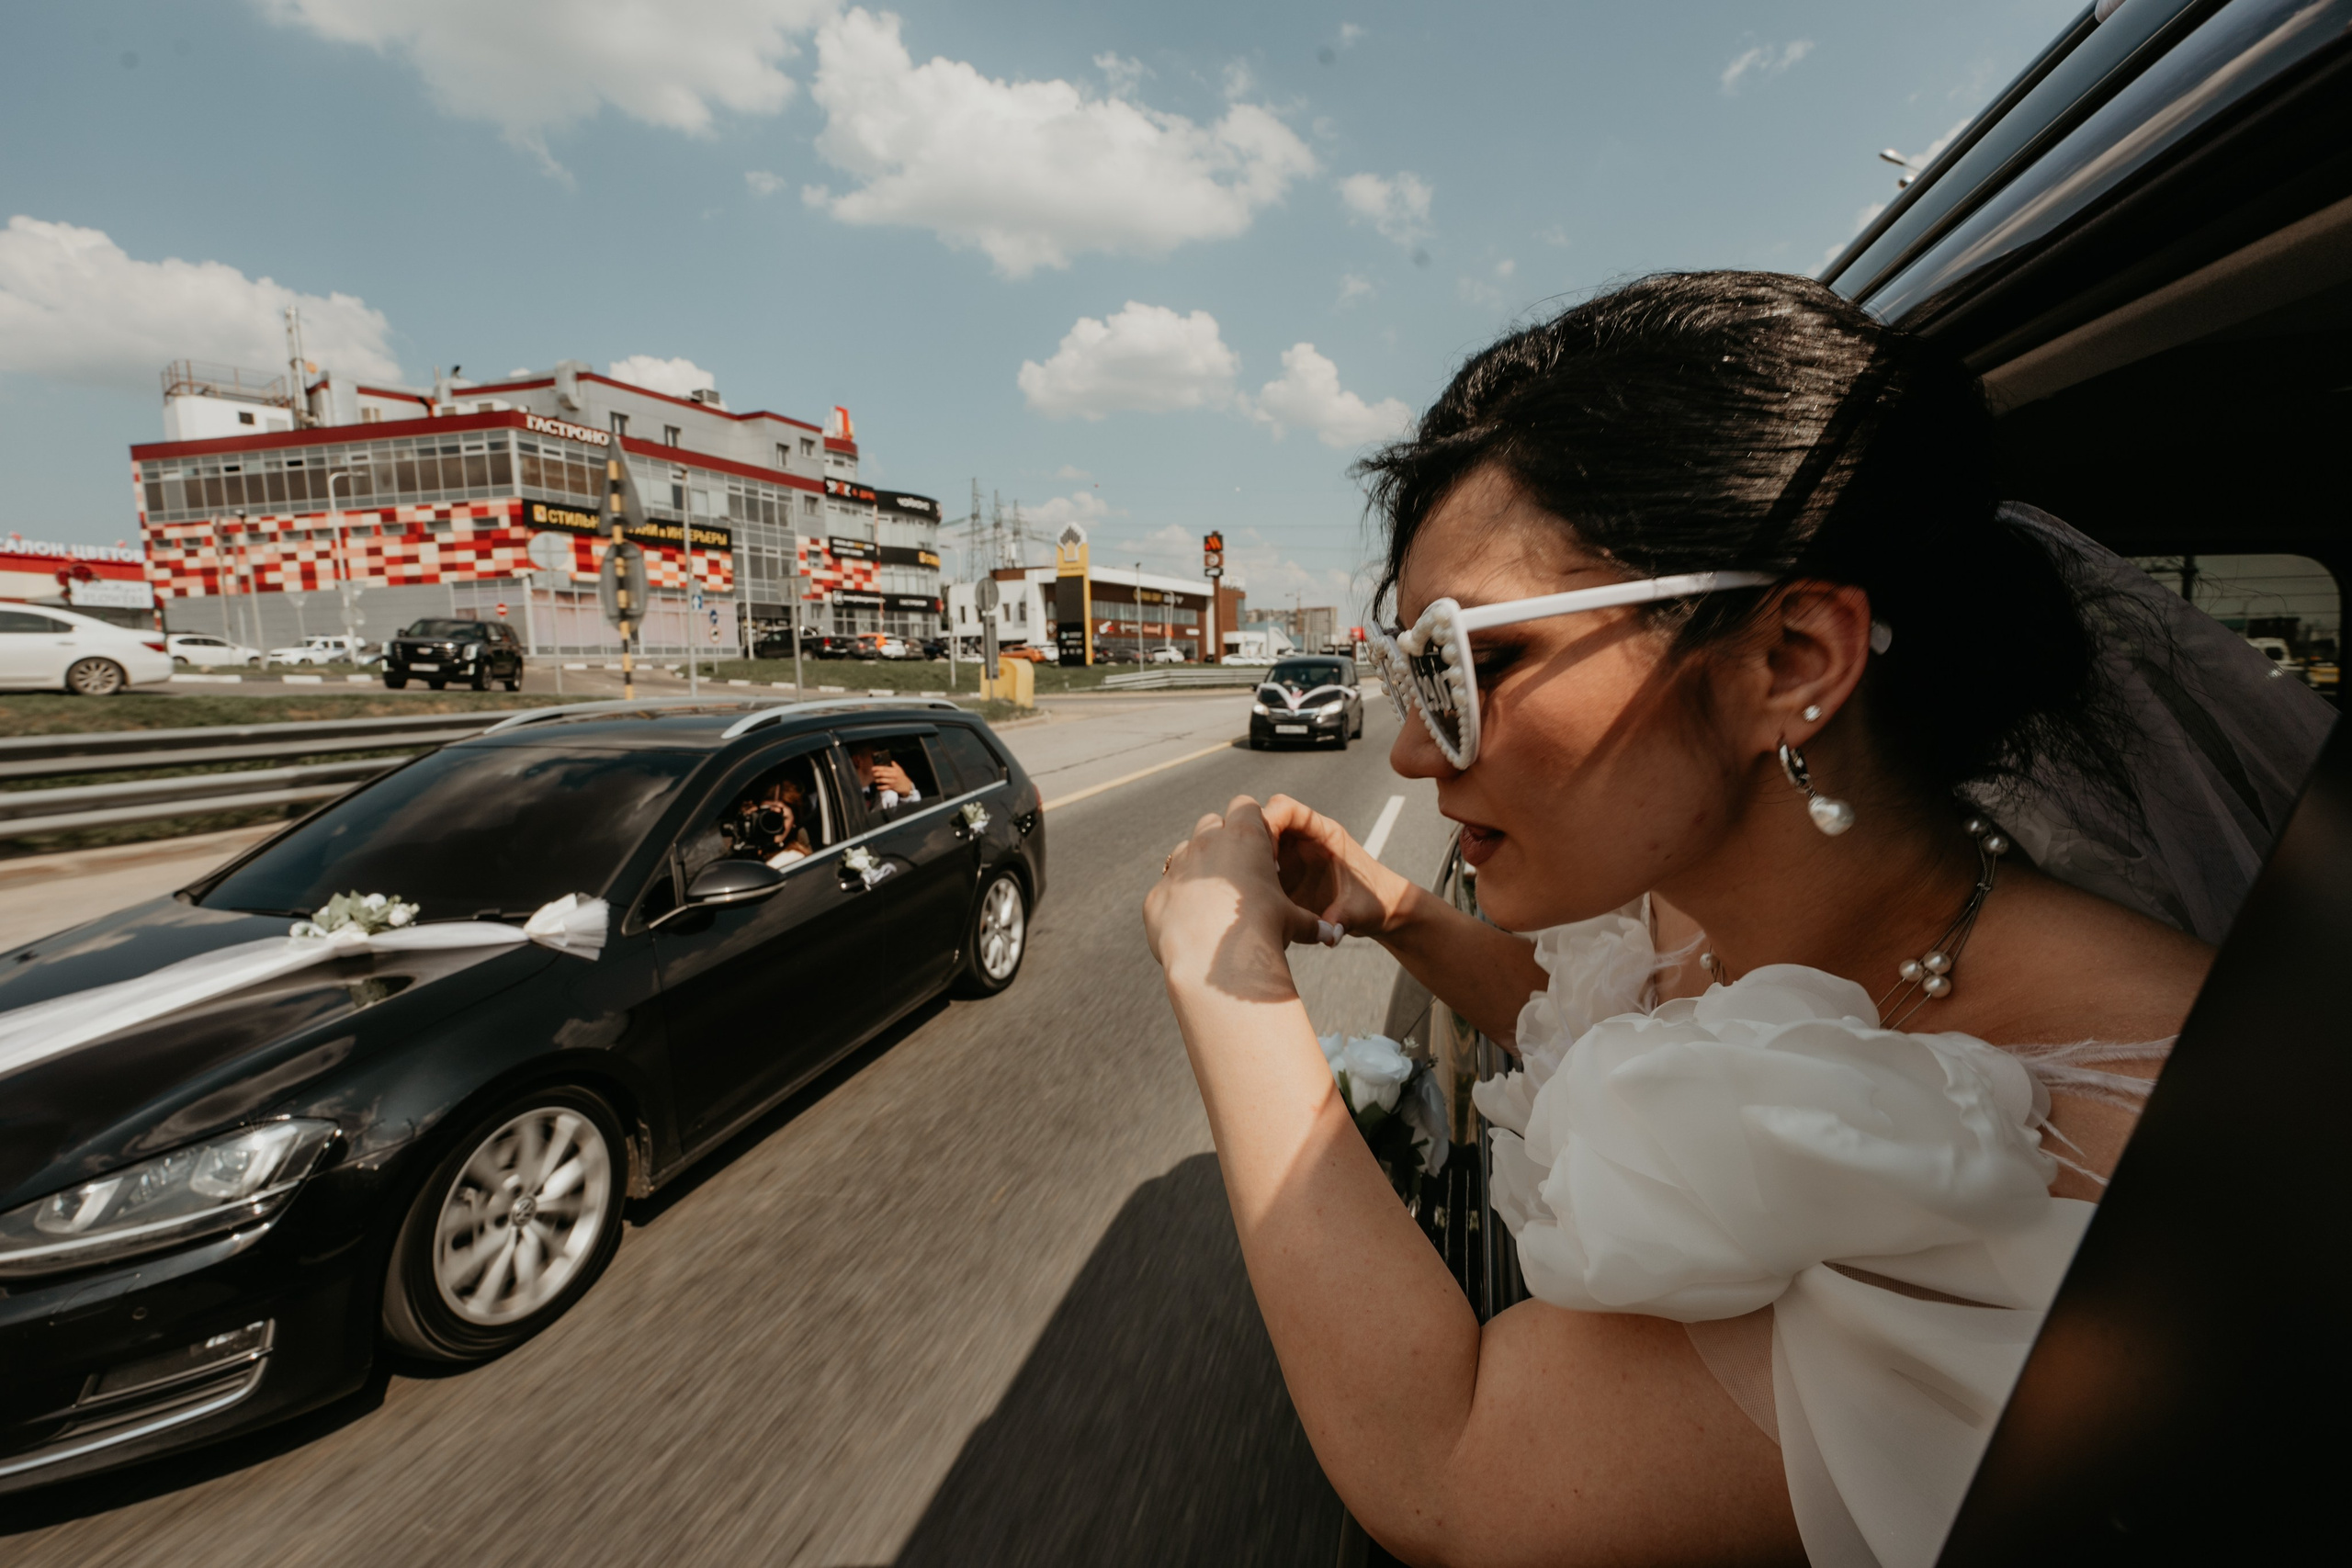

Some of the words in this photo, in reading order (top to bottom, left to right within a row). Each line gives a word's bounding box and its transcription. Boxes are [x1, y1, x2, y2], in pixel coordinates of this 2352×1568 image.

[526, 414, 610, 446] ГАСТРОНО
[548, 509, 600, 529] СТИЛЬН
[666, 525, 728, 547] ИНЕРЬЕРЫ
[71, 544, 145, 563] ЦВЕТОВ
